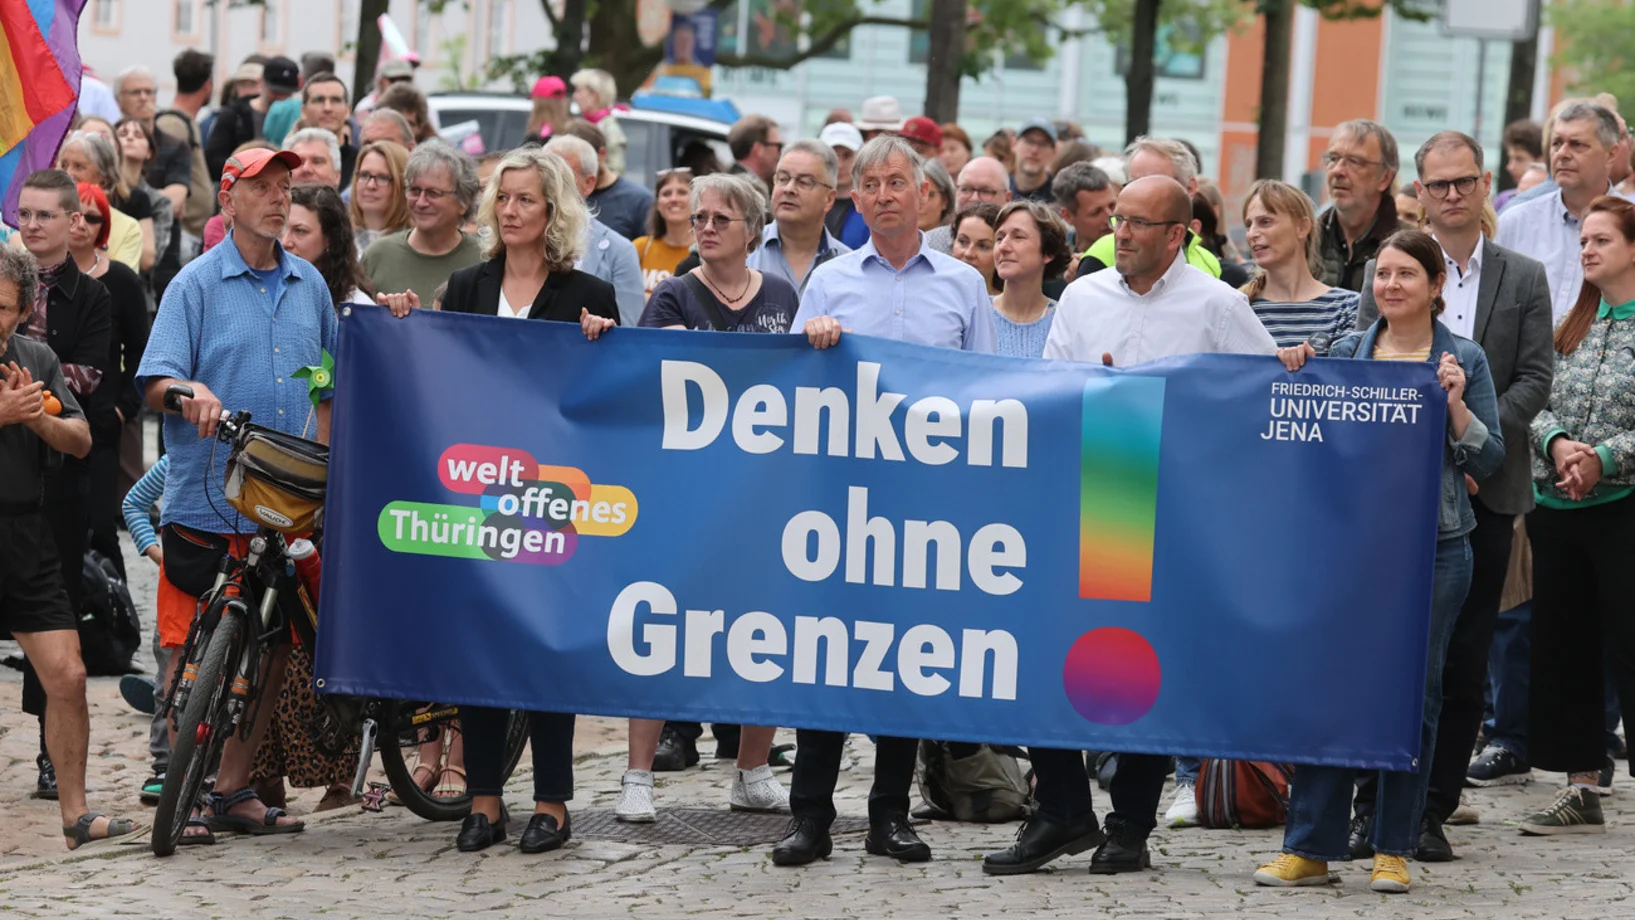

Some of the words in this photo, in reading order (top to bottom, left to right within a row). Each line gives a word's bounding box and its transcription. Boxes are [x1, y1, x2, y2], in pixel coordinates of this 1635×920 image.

[1269, 397, 1423, 425] UNIVERSITÄT
[1271, 382, 1424, 401] FRIEDRICH-SCHILLER-
[661, 360, 1029, 469] Denken
[1260, 420, 1324, 443] JENA
[447, 455, 526, 488] welt
[497, 486, 627, 525] offenes
[389, 508, 566, 560] Thüringen
[781, 485, 1027, 597] ohne
[606, 580, 1019, 701] Grenzen
